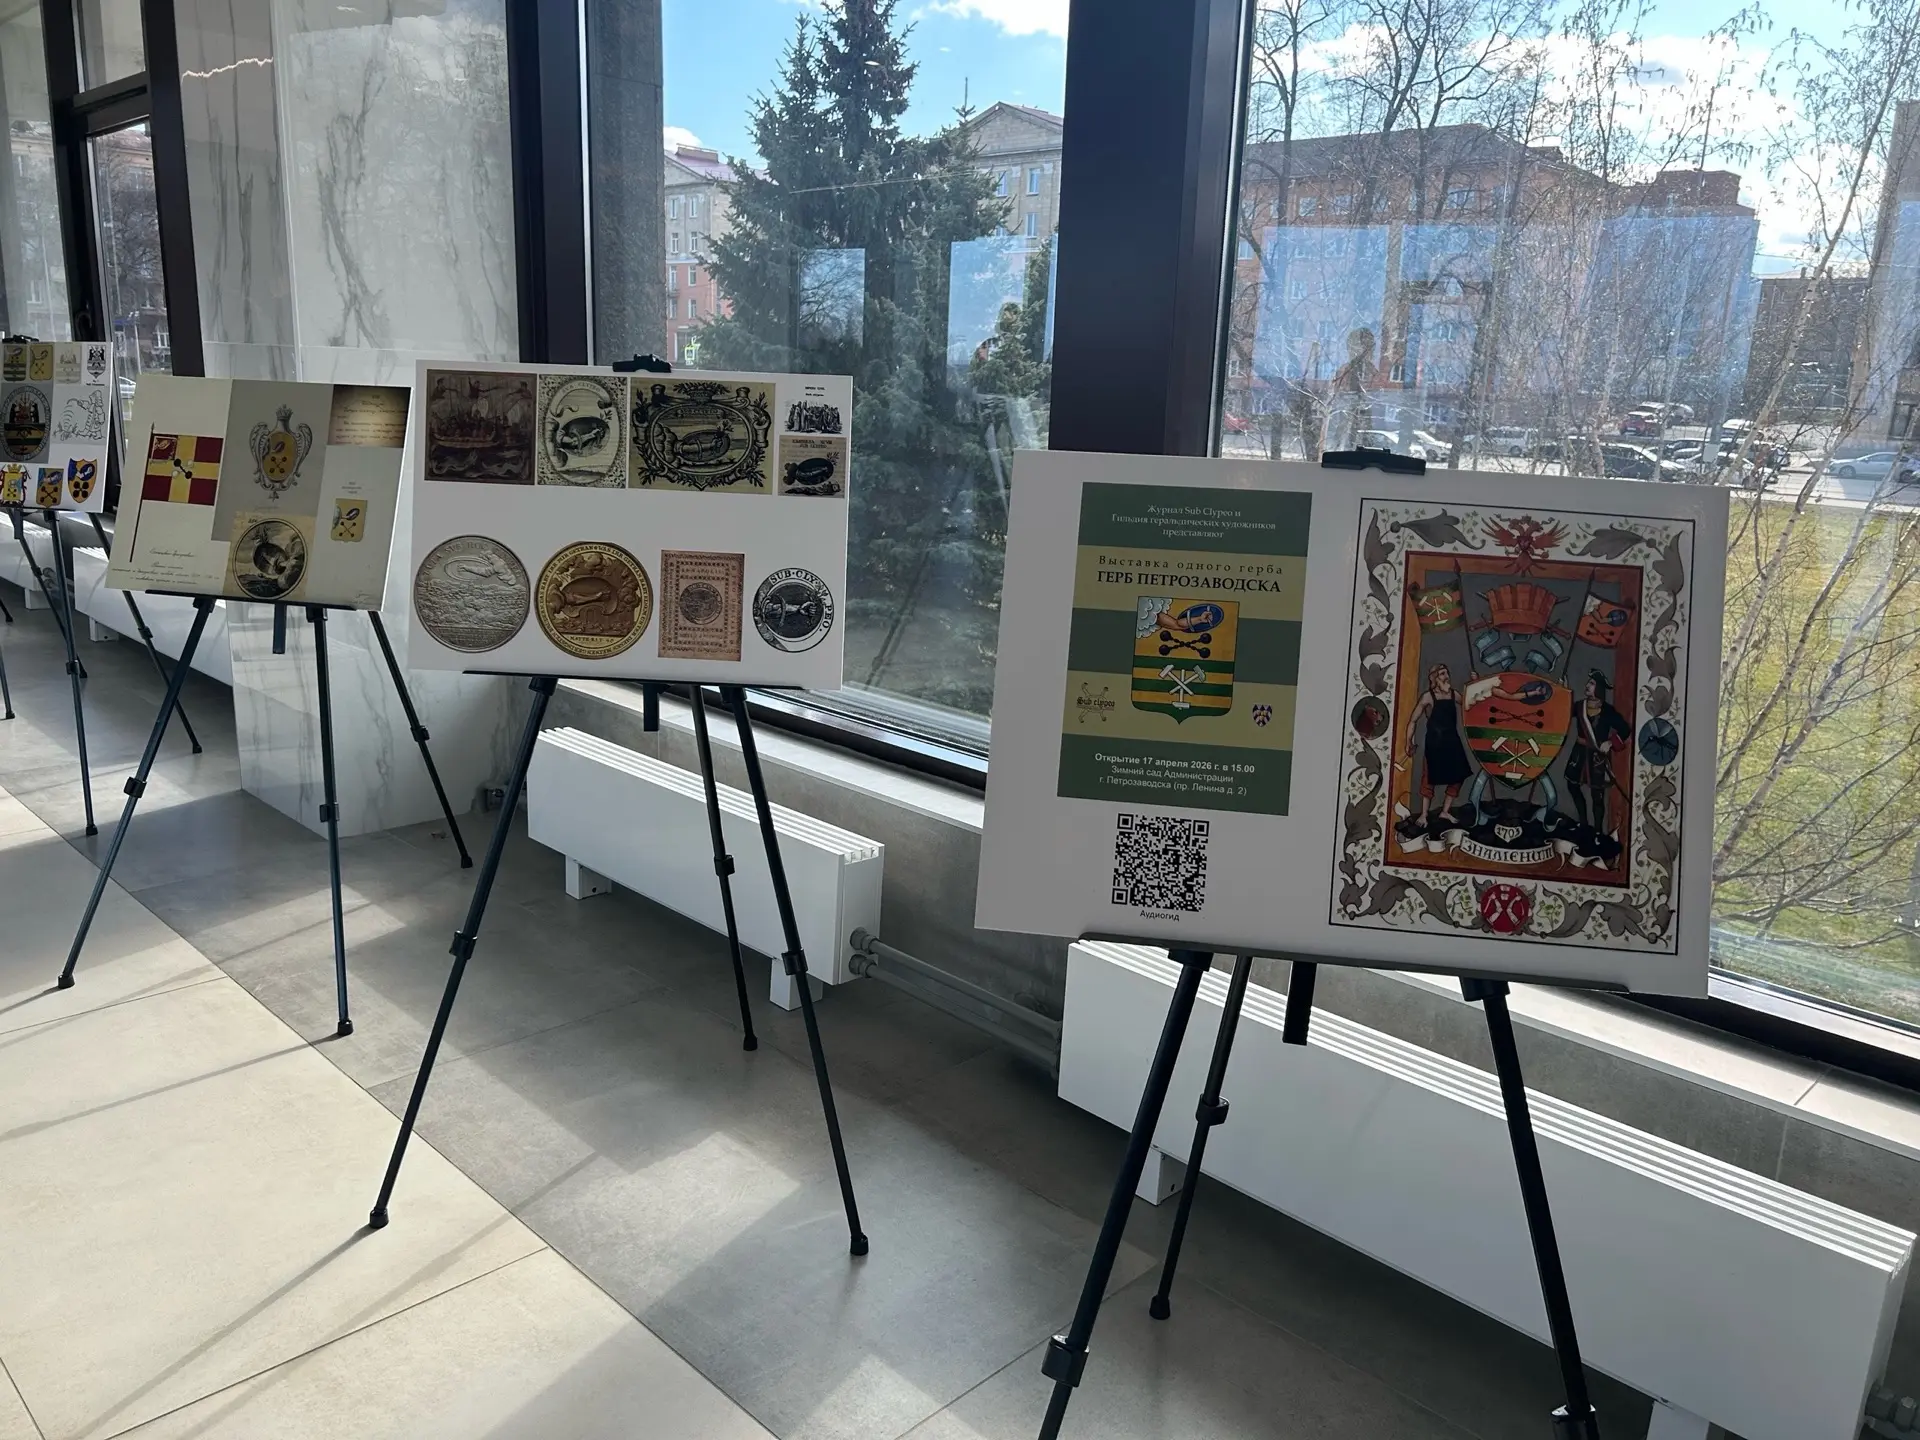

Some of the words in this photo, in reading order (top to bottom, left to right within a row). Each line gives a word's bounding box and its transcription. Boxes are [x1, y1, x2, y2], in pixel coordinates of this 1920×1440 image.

[1147, 504, 1183, 516] Журнал
[1185, 506, 1201, 515] Sub
[1202, 507, 1233, 518] Clypeo
[1112, 513, 1148, 524] Гильдия
[1150, 517, 1219, 528] геральдических
[1221, 521, 1276, 530] художников
[1162, 528, 1224, 538] представляют
[1099, 555, 1169, 569] Выставка
[1177, 560, 1231, 572] одного
[1239, 564, 1283, 575] герба
[1097, 570, 1133, 584] ГЕРБ
[1138, 574, 1281, 593] ПЕТРОЗАВОДСКА
[1095, 752, 1140, 765] Открытие
[1143, 756, 1153, 766] 17
[1155, 759, 1188, 770] апреля
[1190, 760, 1212, 770] 2026
[1231, 764, 1255, 773] 15.00
[1111, 765, 1144, 777] Зимний
[1146, 769, 1162, 778] сад
[1164, 769, 1234, 783] Администрации
[1107, 776, 1171, 789] Петрозаводска
[1174, 781, 1189, 792] (пр.
[1192, 783, 1225, 794] Ленина
[1237, 786, 1247, 797] 2)
[1140, 909, 1180, 921] Аудиогид
